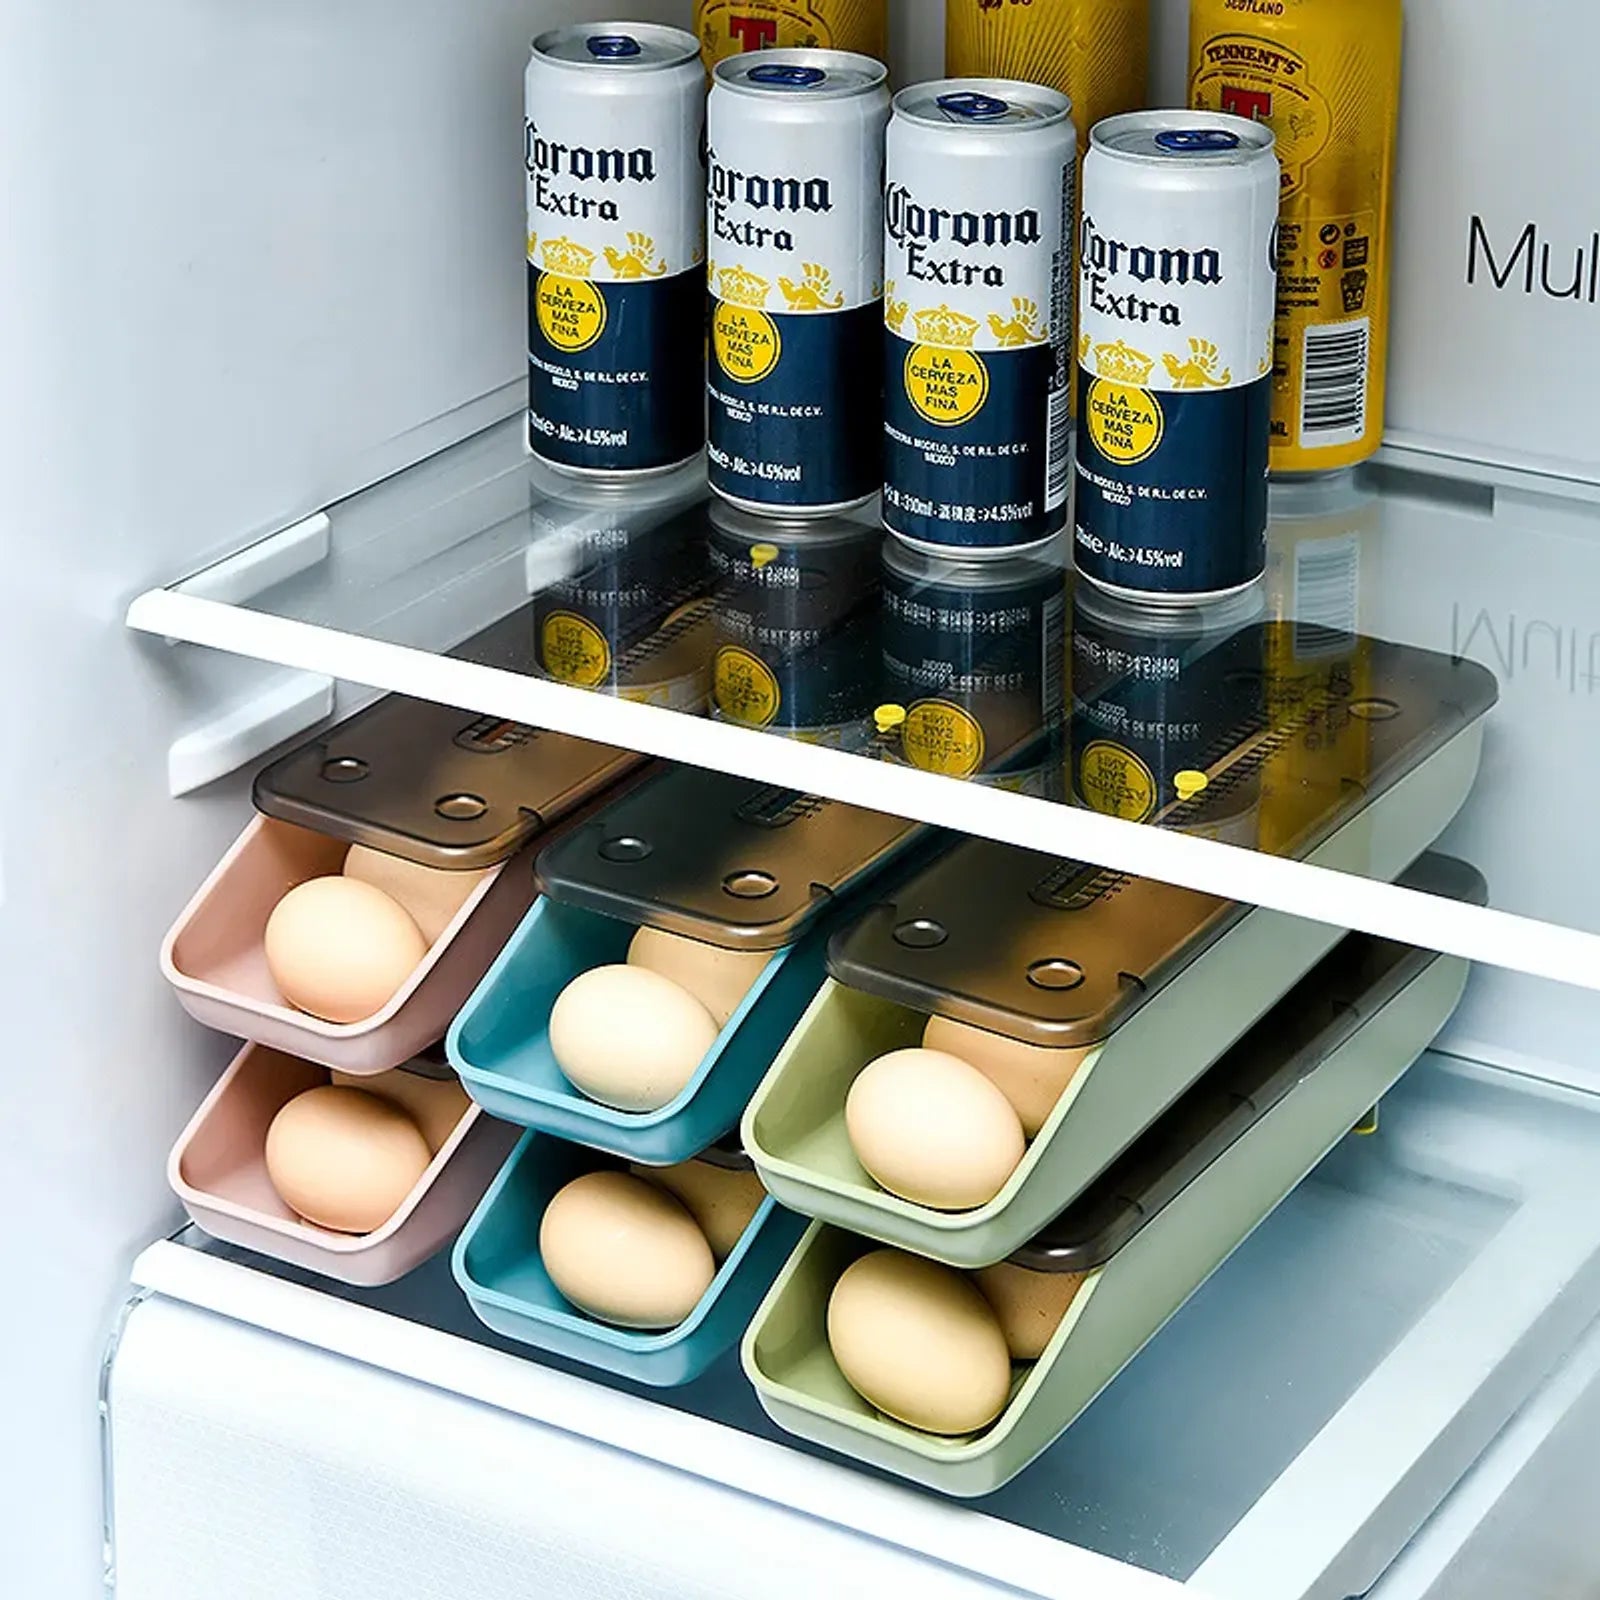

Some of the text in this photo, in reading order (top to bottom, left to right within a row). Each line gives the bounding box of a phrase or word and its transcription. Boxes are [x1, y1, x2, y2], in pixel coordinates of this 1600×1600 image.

[1206, 44, 1304, 75] TENNENT'S
[535, 173, 619, 221] Extra
[886, 181, 1041, 247] Corona
[713, 200, 794, 251] Extra
[906, 240, 1004, 287] Extra
[556, 284, 573, 298] LA
[1090, 271, 1181, 326] Extra
[541, 292, 597, 314] CERVEZA
[552, 309, 579, 325] MAS
[731, 314, 749, 329] LA
[552, 322, 579, 338] FINA
[717, 321, 770, 345] CERVEZA
[727, 340, 753, 357] MAS
[727, 351, 754, 369] FINA
[932, 356, 952, 369] LA
[911, 364, 978, 385] CERVEZA
[926, 382, 958, 398] MAS
[1110, 391, 1128, 407] LA
[925, 396, 960, 411] FINA
[1092, 399, 1153, 425] CERVEZA
[1104, 418, 1133, 437] MAS
[1103, 432, 1134, 450] FINA
